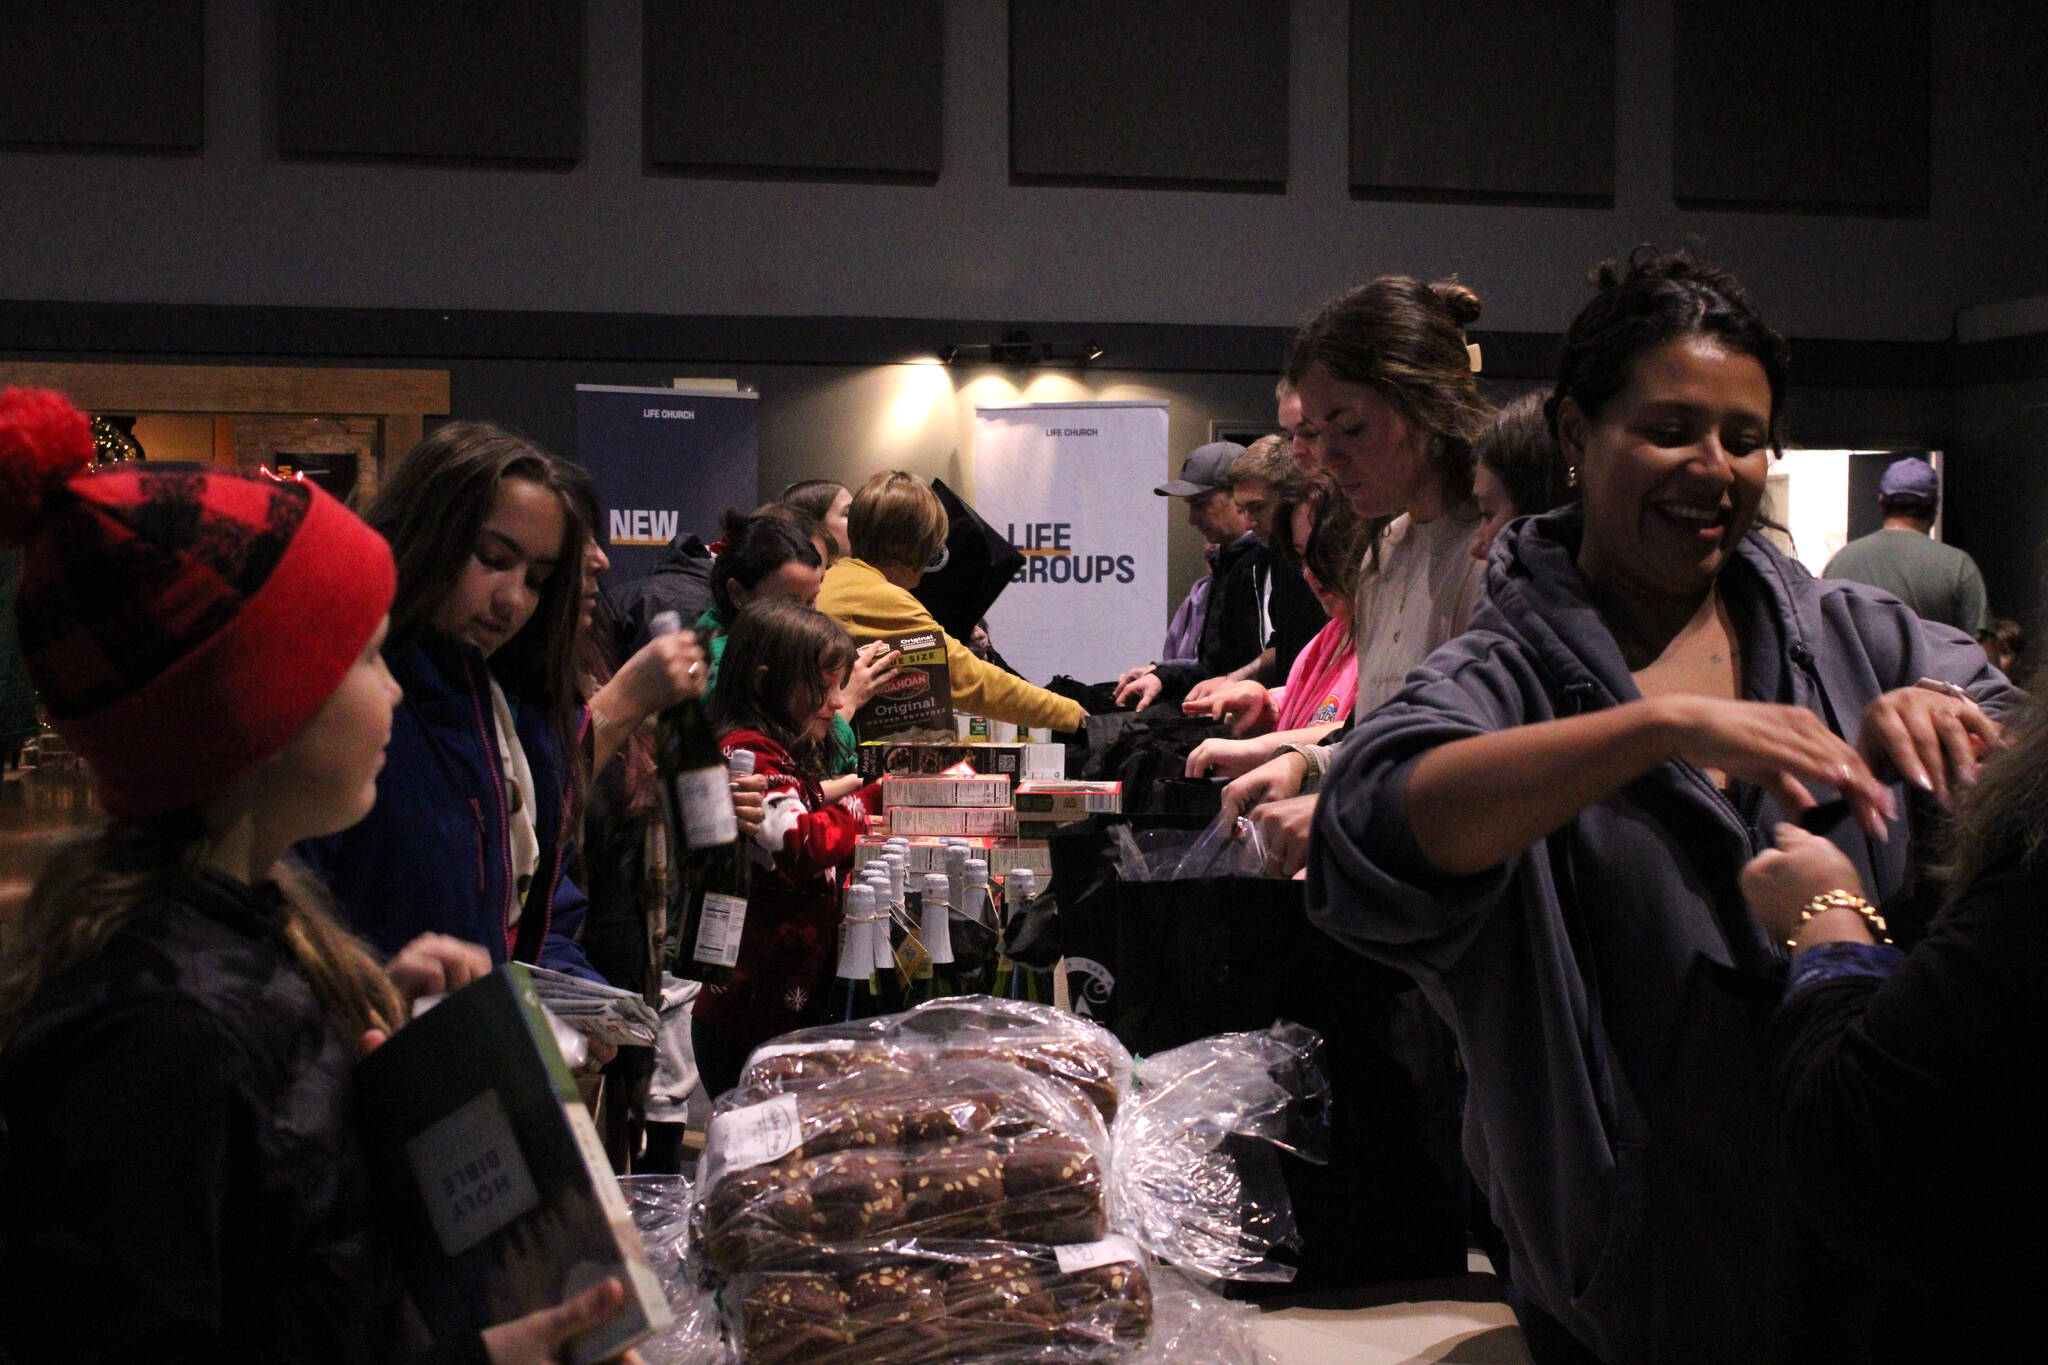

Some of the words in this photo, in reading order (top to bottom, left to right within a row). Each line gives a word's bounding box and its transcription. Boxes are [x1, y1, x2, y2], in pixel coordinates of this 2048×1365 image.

[643, 409, 660, 419] LIFE
[661, 410, 695, 420] CHURCH
[1046, 429, 1062, 437] LIFE
[1064, 428, 1098, 437] CHURCH
[610, 509, 679, 541] NEW
[1008, 523, 1071, 551] LIFE
[900, 634, 934, 645] Original
[909, 651, 935, 663] SIZE
[875, 696, 935, 716] Original
[442, 1149, 498, 1197] BIBLE
[454, 1172, 511, 1222] HOLY
